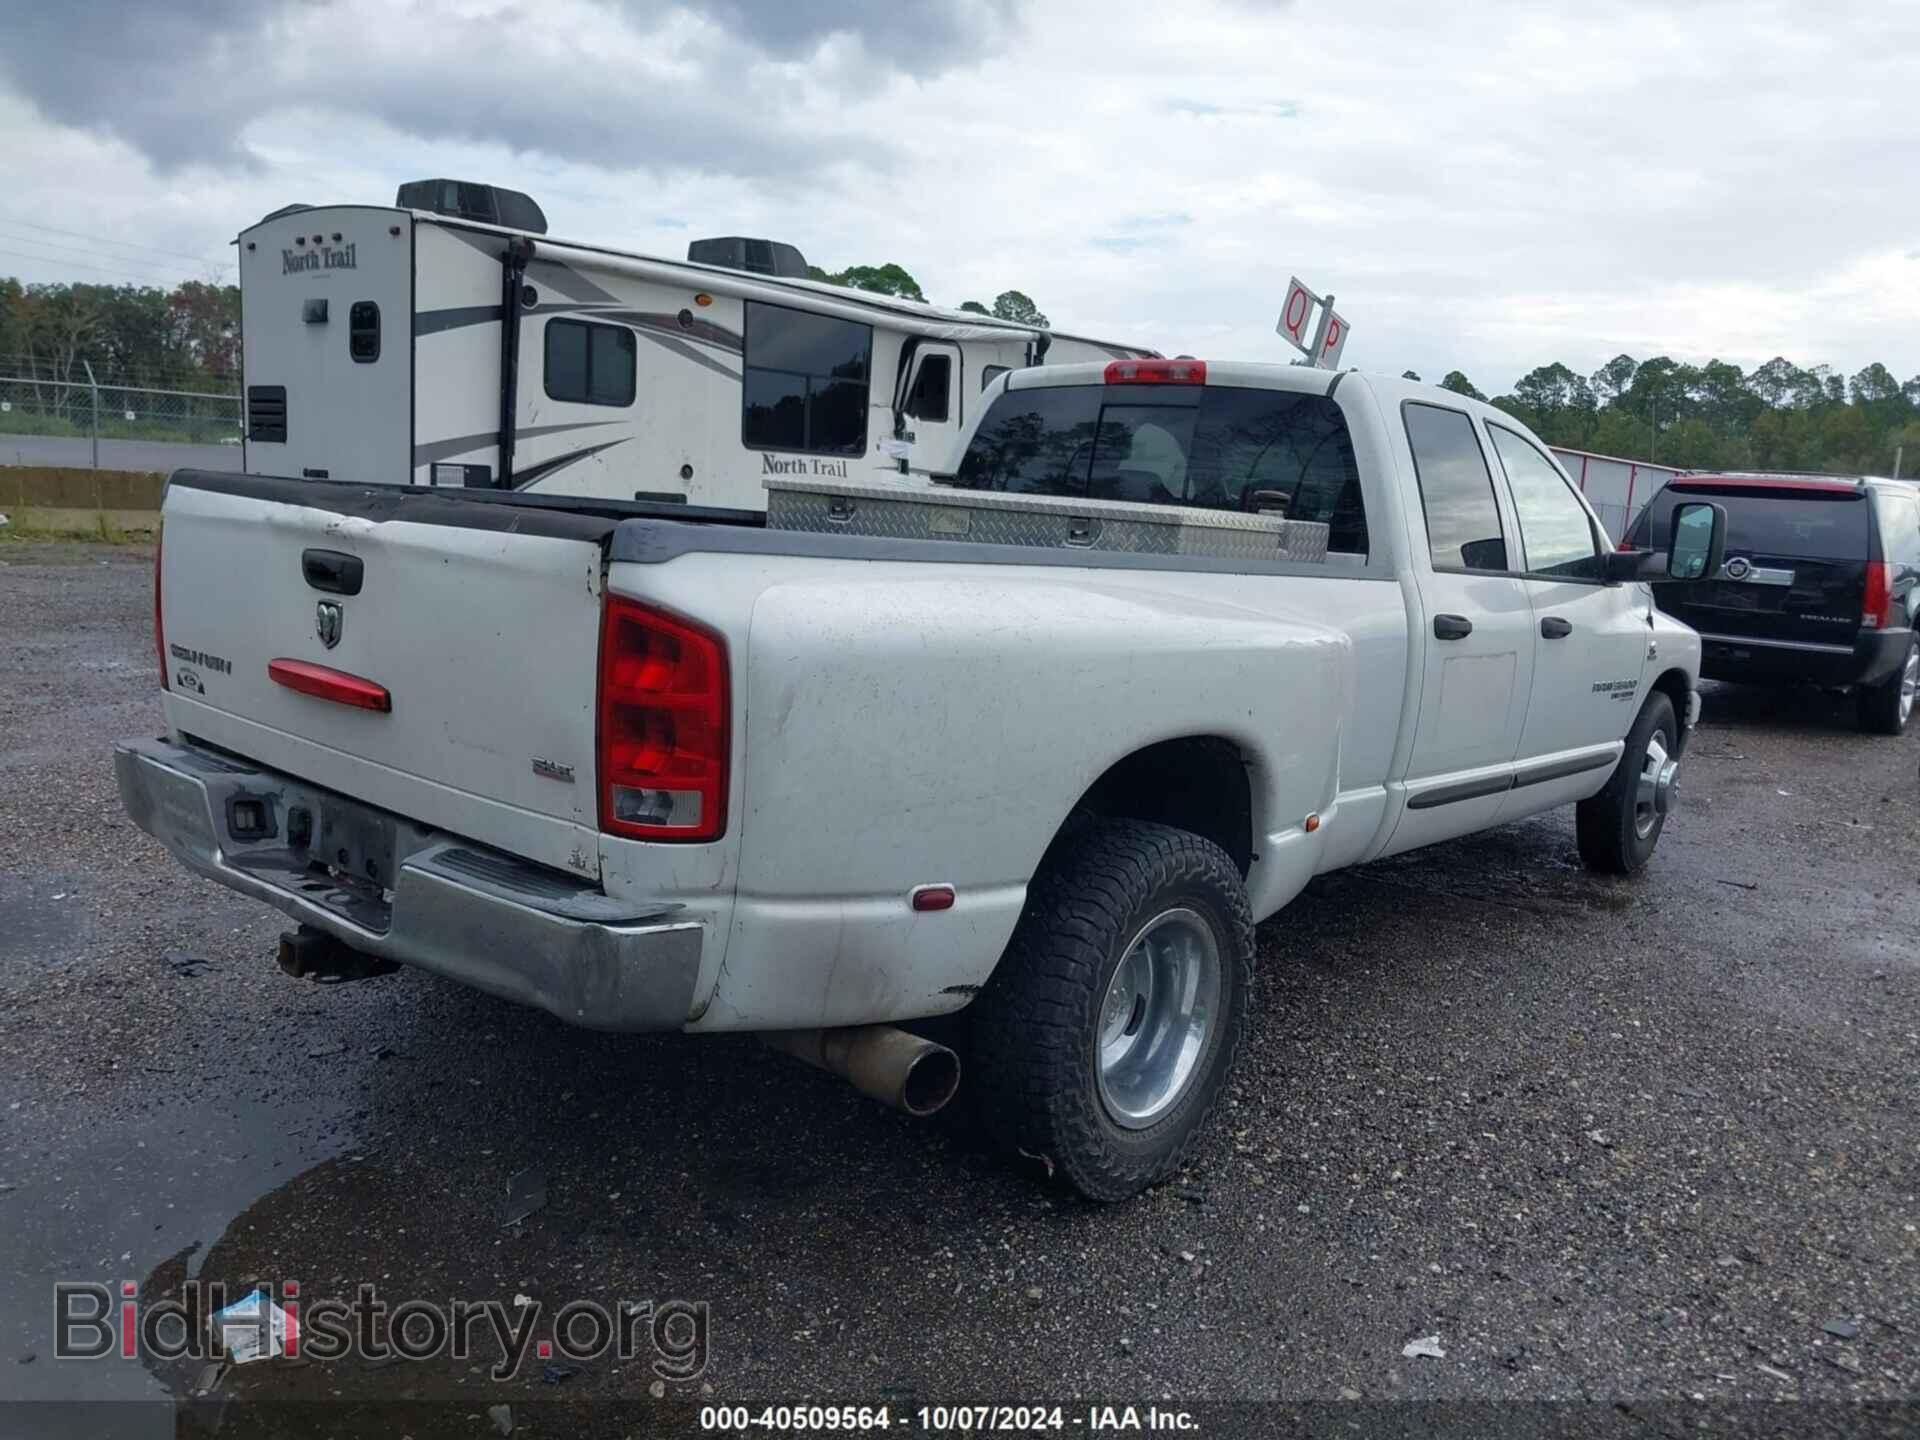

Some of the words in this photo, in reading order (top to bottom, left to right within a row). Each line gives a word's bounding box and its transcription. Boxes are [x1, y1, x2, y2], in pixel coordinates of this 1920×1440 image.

[282, 249, 320, 275] North
[320, 243, 357, 270] Trail
[1286, 287, 1307, 341] Q
[1322, 319, 1340, 359] P
[761, 452, 807, 475] North
[808, 458, 848, 478] Trail
